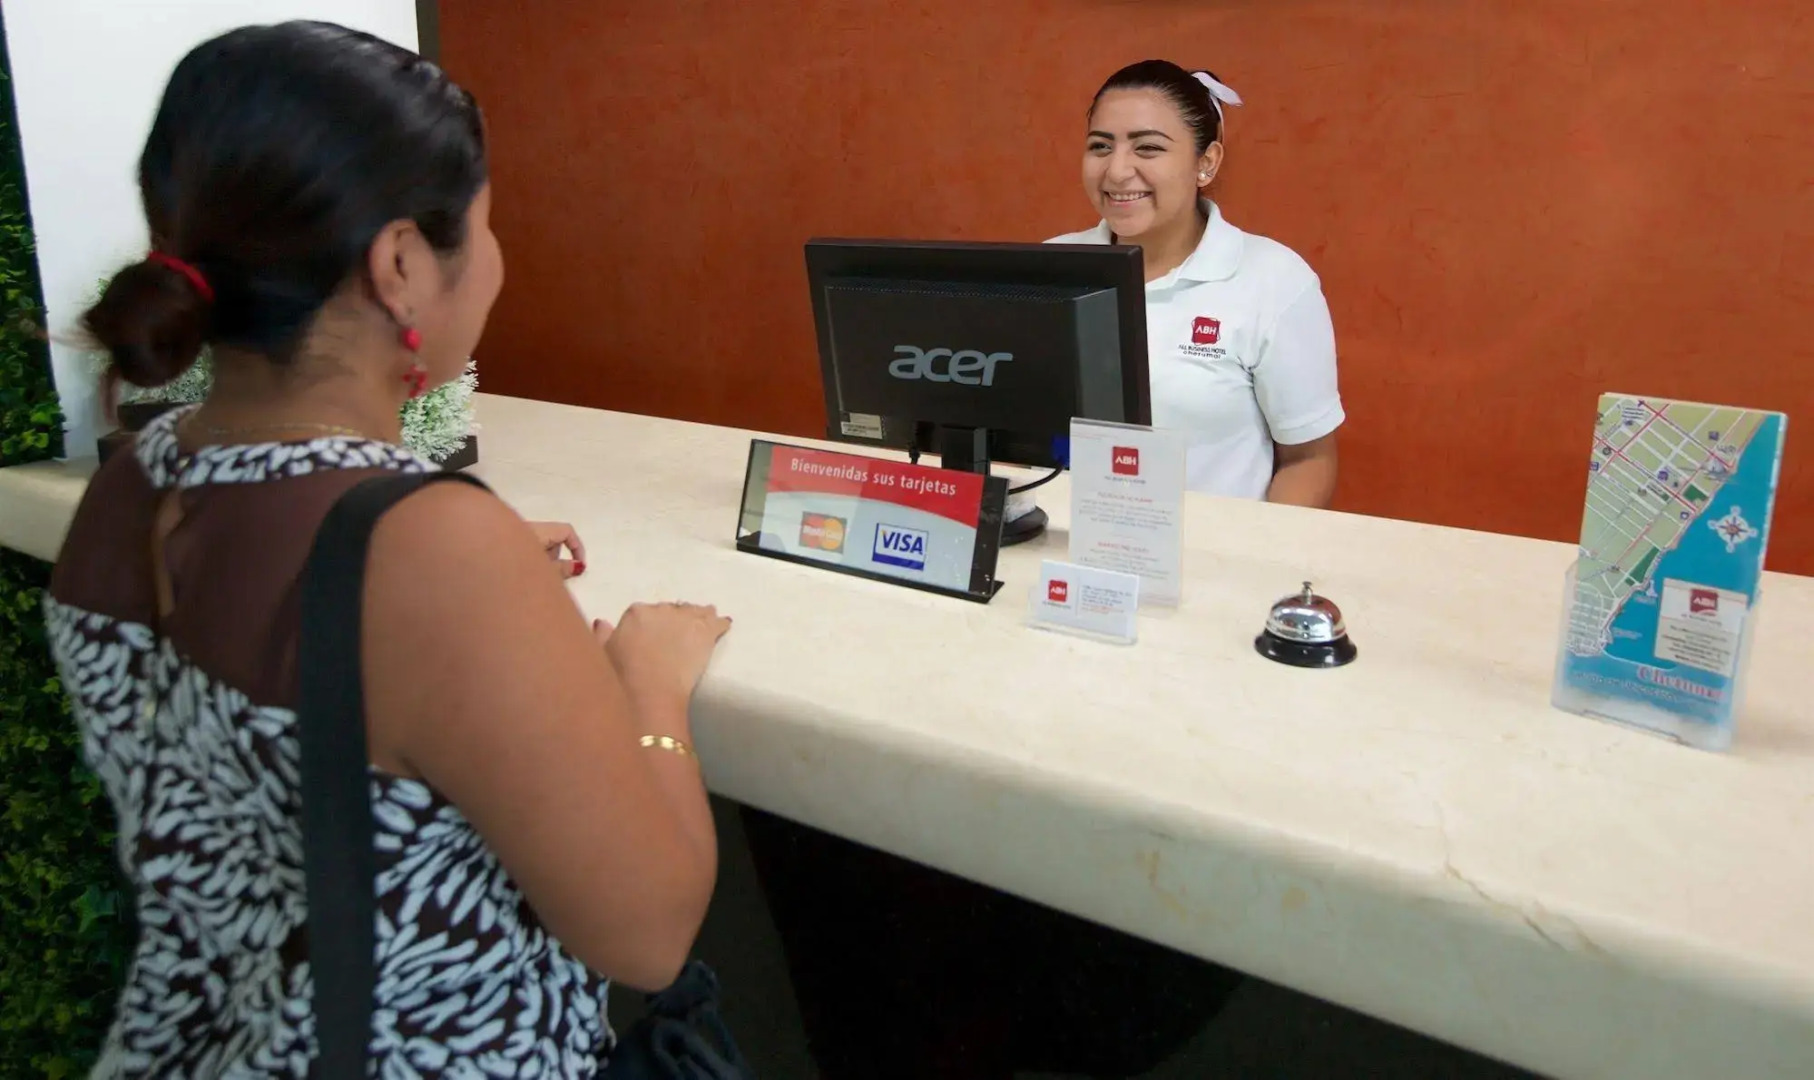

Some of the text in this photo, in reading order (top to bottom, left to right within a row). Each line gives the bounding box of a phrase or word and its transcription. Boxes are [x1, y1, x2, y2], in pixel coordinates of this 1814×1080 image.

[1195, 325, 1217, 335] ABH
[888, 345, 1013, 386] acer
[1115, 455, 1137, 466] ABH
[791, 458, 957, 496] Bienvenidas sus tarjetas
[881, 530, 924, 555] VISA
